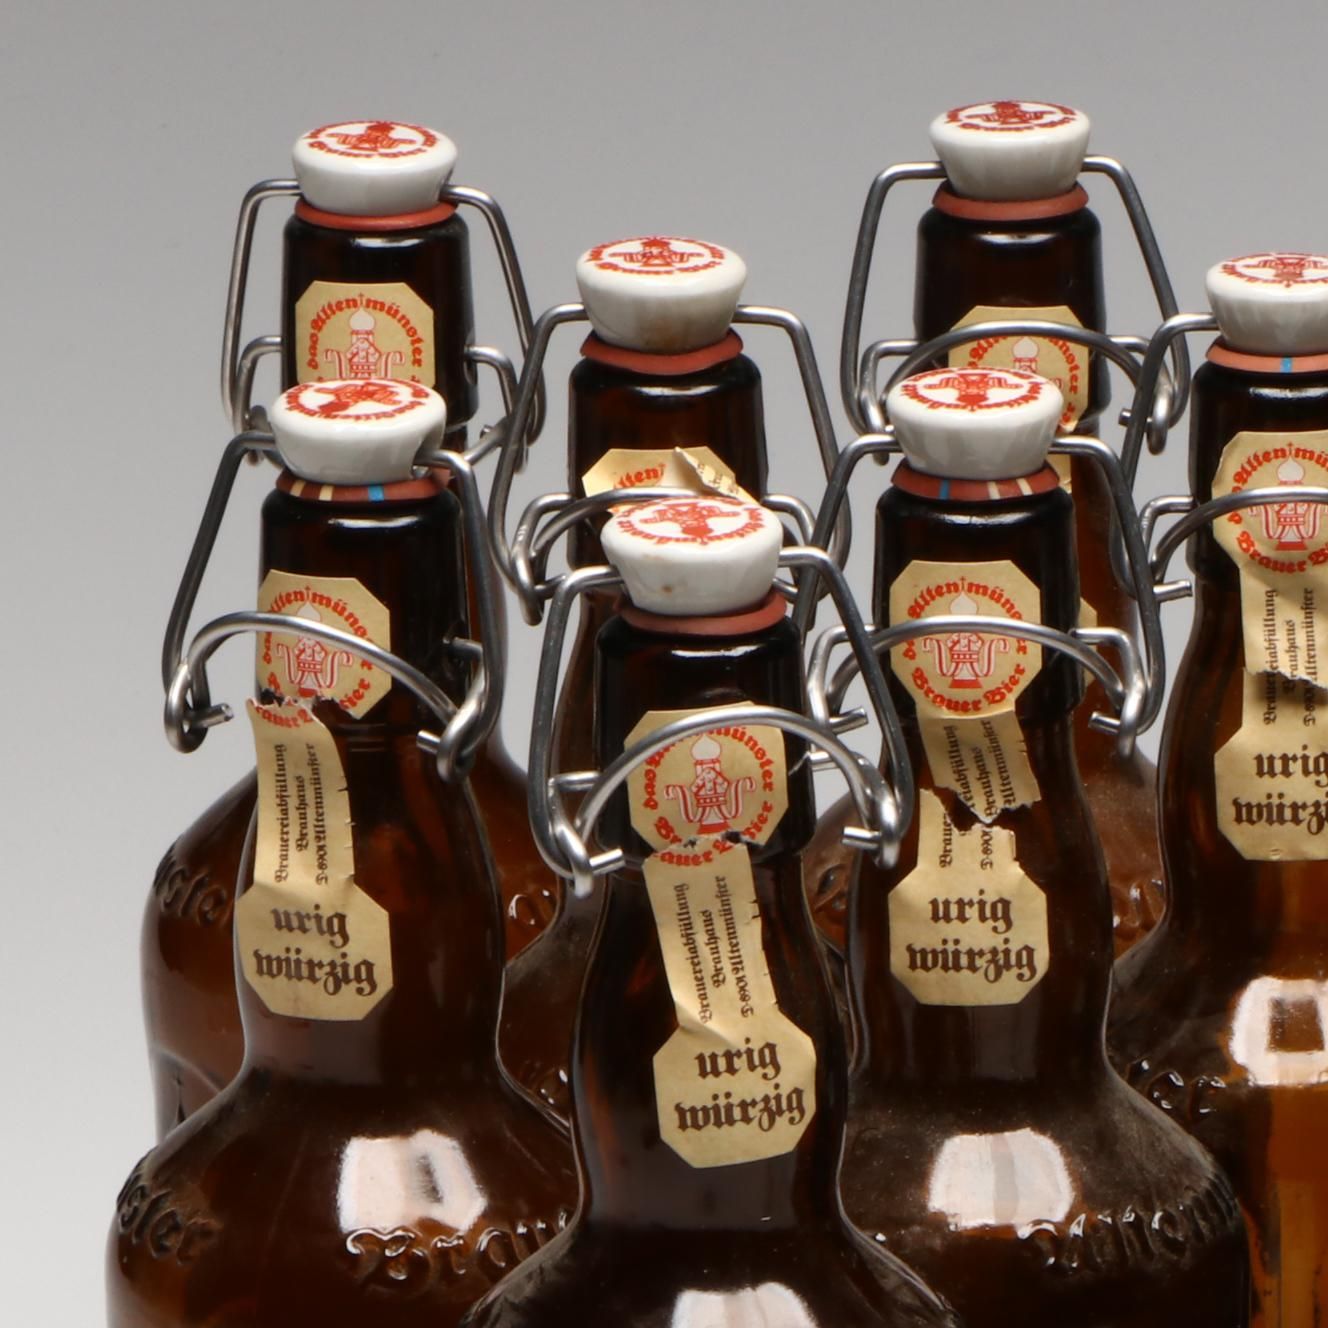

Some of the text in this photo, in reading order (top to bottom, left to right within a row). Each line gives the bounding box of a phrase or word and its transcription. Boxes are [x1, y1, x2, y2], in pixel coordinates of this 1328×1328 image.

[271, 904, 350, 949] urig
[929, 888, 1013, 934] urig
[253, 948, 377, 997] würzig
[906, 937, 1038, 985] würzig
[694, 1037, 781, 1081] urig
[674, 1083, 807, 1132] würzig
